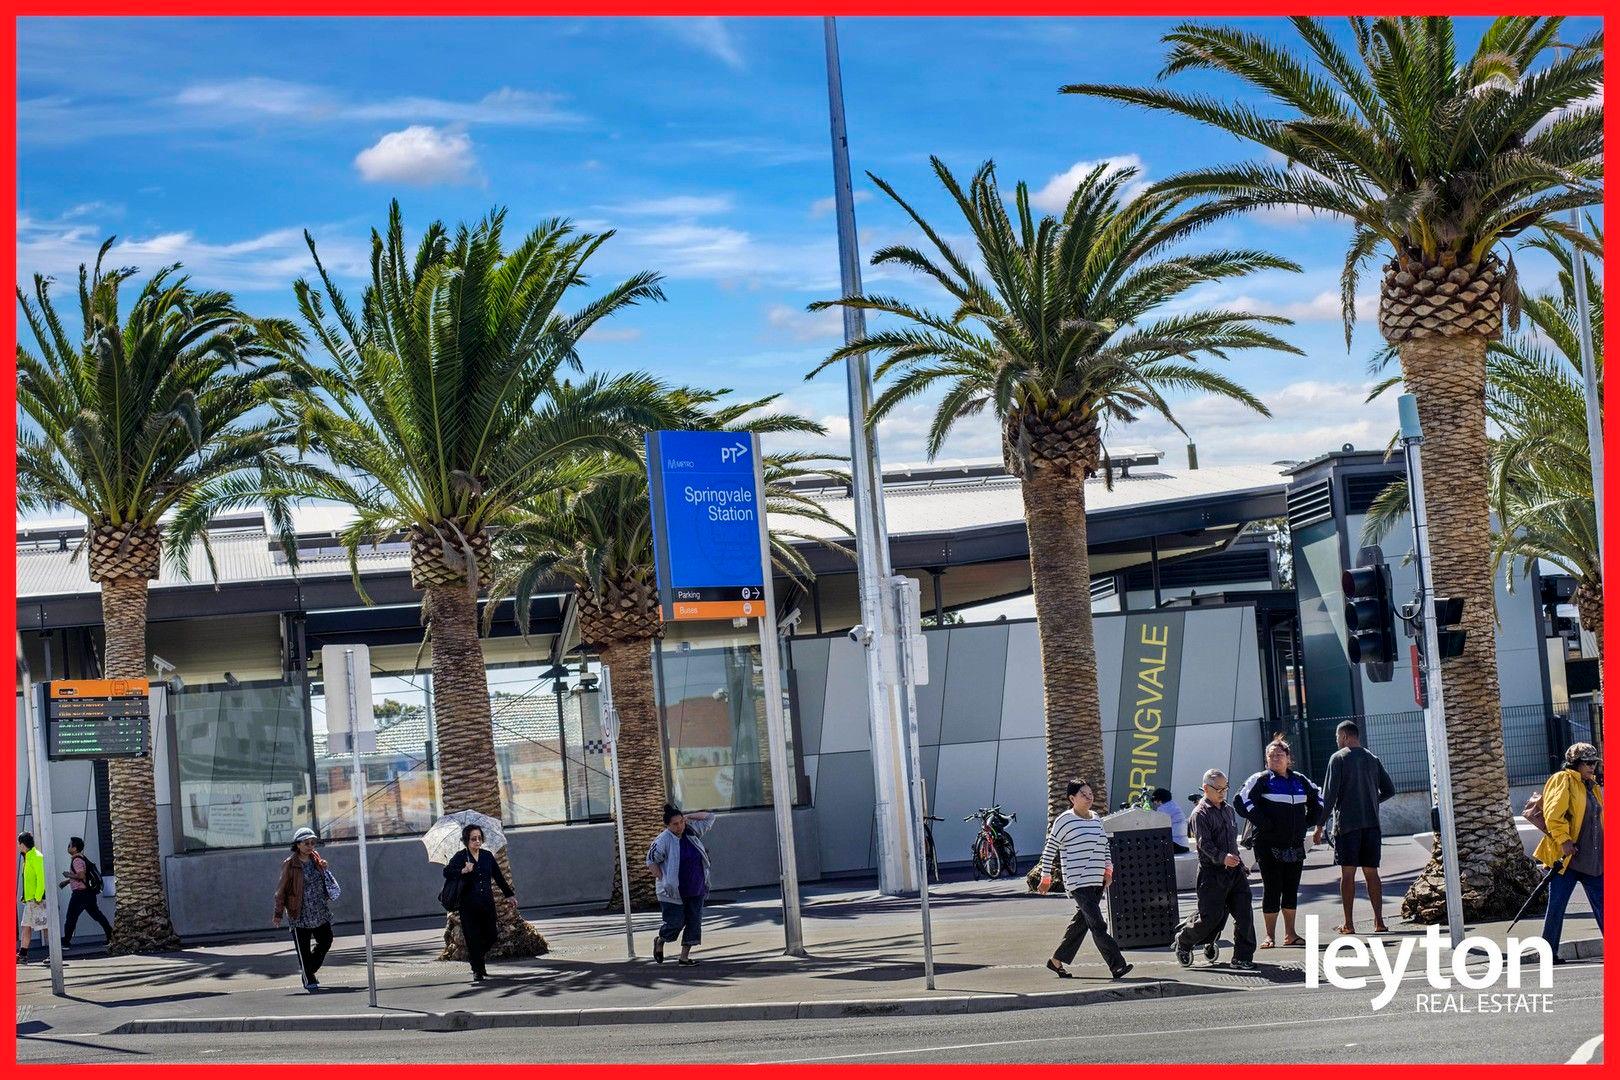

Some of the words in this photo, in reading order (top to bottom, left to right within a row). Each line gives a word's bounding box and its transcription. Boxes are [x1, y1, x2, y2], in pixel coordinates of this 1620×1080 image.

[684, 486, 752, 506] Springvale
[708, 505, 753, 521] Station
[678, 590, 701, 600] Parking
[680, 606, 698, 614] Buses
